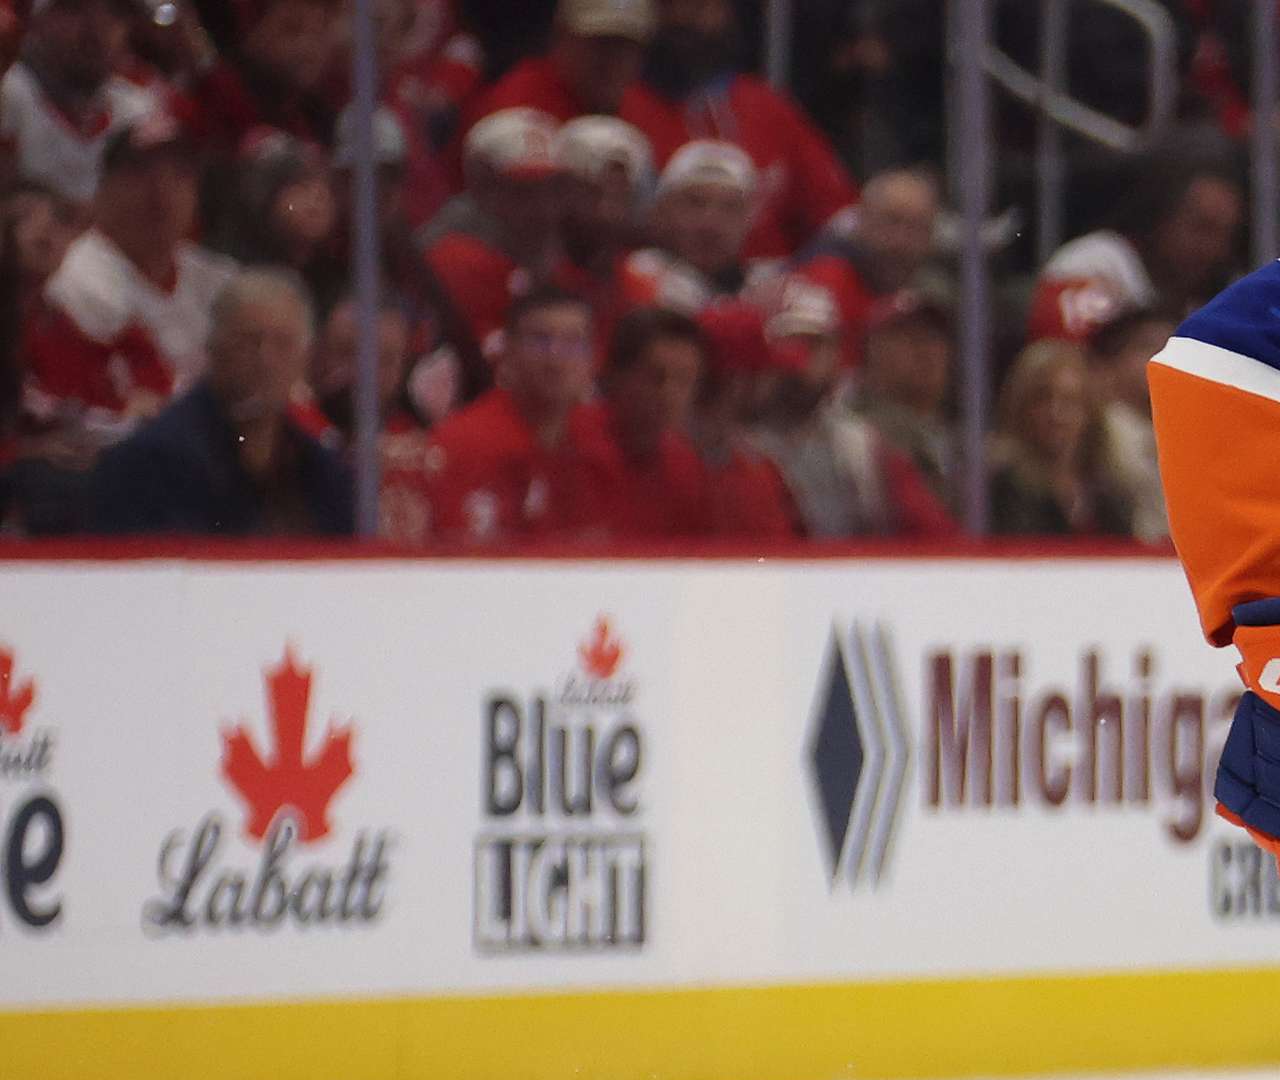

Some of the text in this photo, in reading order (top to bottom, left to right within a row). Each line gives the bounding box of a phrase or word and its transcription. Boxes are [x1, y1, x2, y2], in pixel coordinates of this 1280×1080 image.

[484, 694, 642, 815] Blue
[924, 645, 1243, 842] Michig
[146, 808, 390, 930] Labatt
[480, 840, 644, 948] LIGHT
